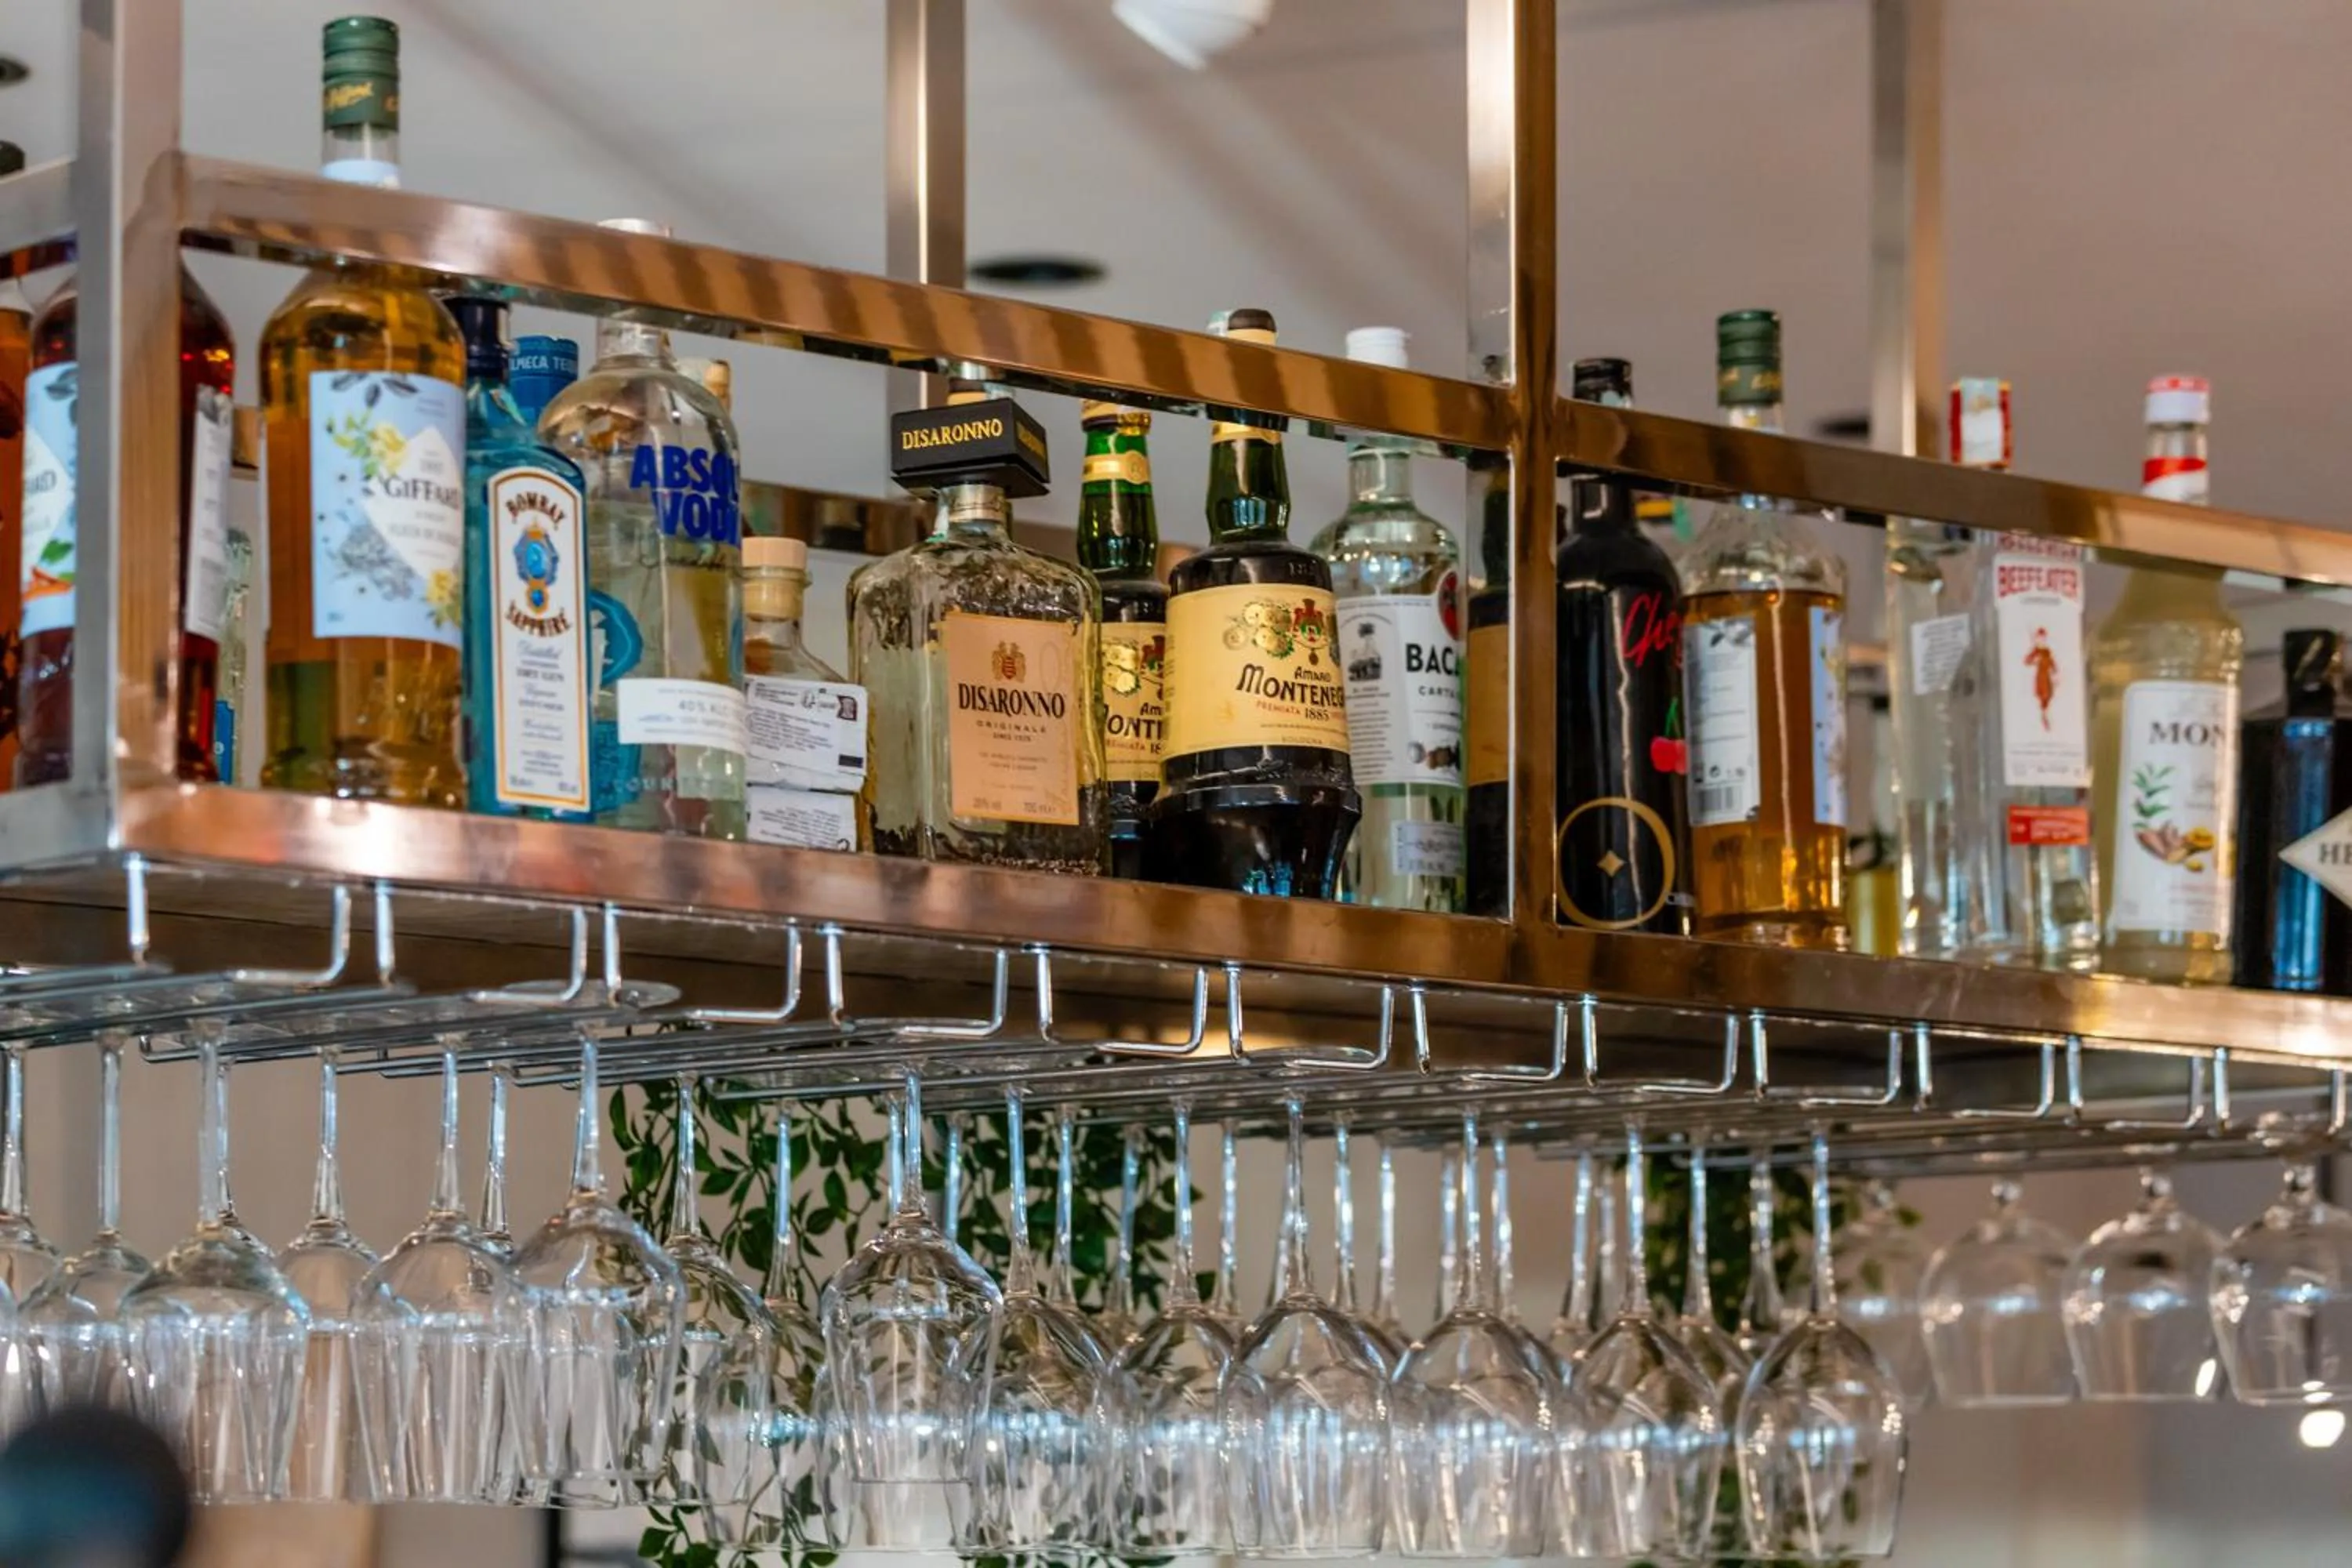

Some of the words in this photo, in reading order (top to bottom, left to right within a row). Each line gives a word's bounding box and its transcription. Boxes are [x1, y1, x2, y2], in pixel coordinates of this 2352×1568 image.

[508, 354, 549, 371] LMECA
[902, 418, 1004, 450] DISARONNO
[506, 491, 567, 529] BOMBAY
[1998, 565, 2078, 599] BEEFEATER
[506, 600, 571, 637] SAPPHIRE
[958, 683, 1065, 719] DISARONNO
[1305, 707, 1330, 721] 1885
[1104, 702, 1161, 741] ONT
